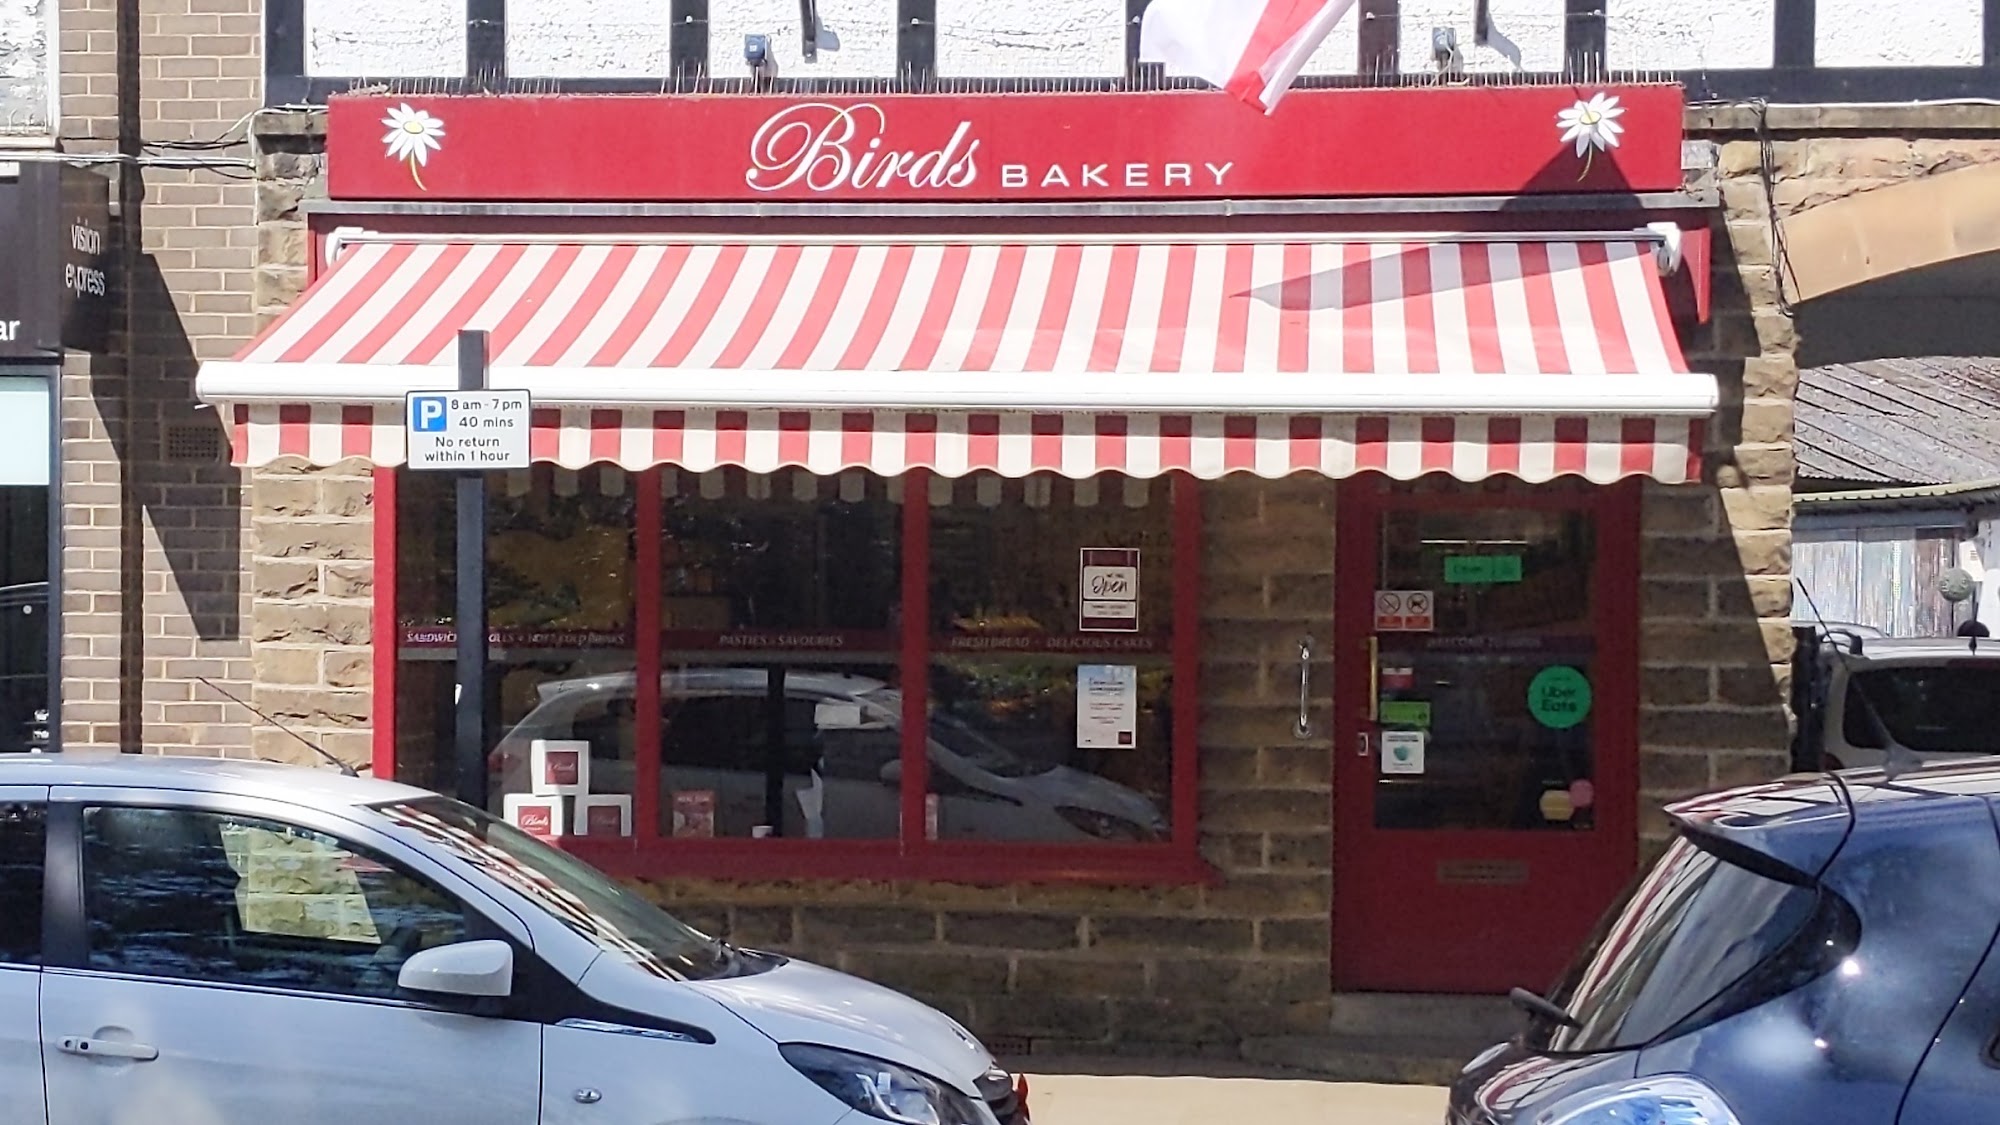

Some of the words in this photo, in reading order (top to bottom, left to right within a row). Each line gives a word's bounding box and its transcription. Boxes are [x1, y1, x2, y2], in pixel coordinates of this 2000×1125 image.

[745, 102, 981, 192] Birds
[1000, 162, 1234, 189] BAKERY
[71, 216, 100, 255] vision
[65, 263, 105, 298] express
[420, 400, 442, 429] P
[459, 416, 478, 427] 40
[483, 417, 514, 427] mins
[435, 436, 454, 447] No
[458, 437, 500, 447] return
[425, 451, 465, 461] within
[480, 450, 510, 461] hour
[1091, 575, 1128, 597] Open
[719, 634, 767, 646] PASTIES
[777, 634, 844, 646] SAVOURIES
[1047, 636, 1111, 648] DELICIOUS
[1541, 685, 1576, 698] Uber
[1541, 698, 1577, 713] Eats
